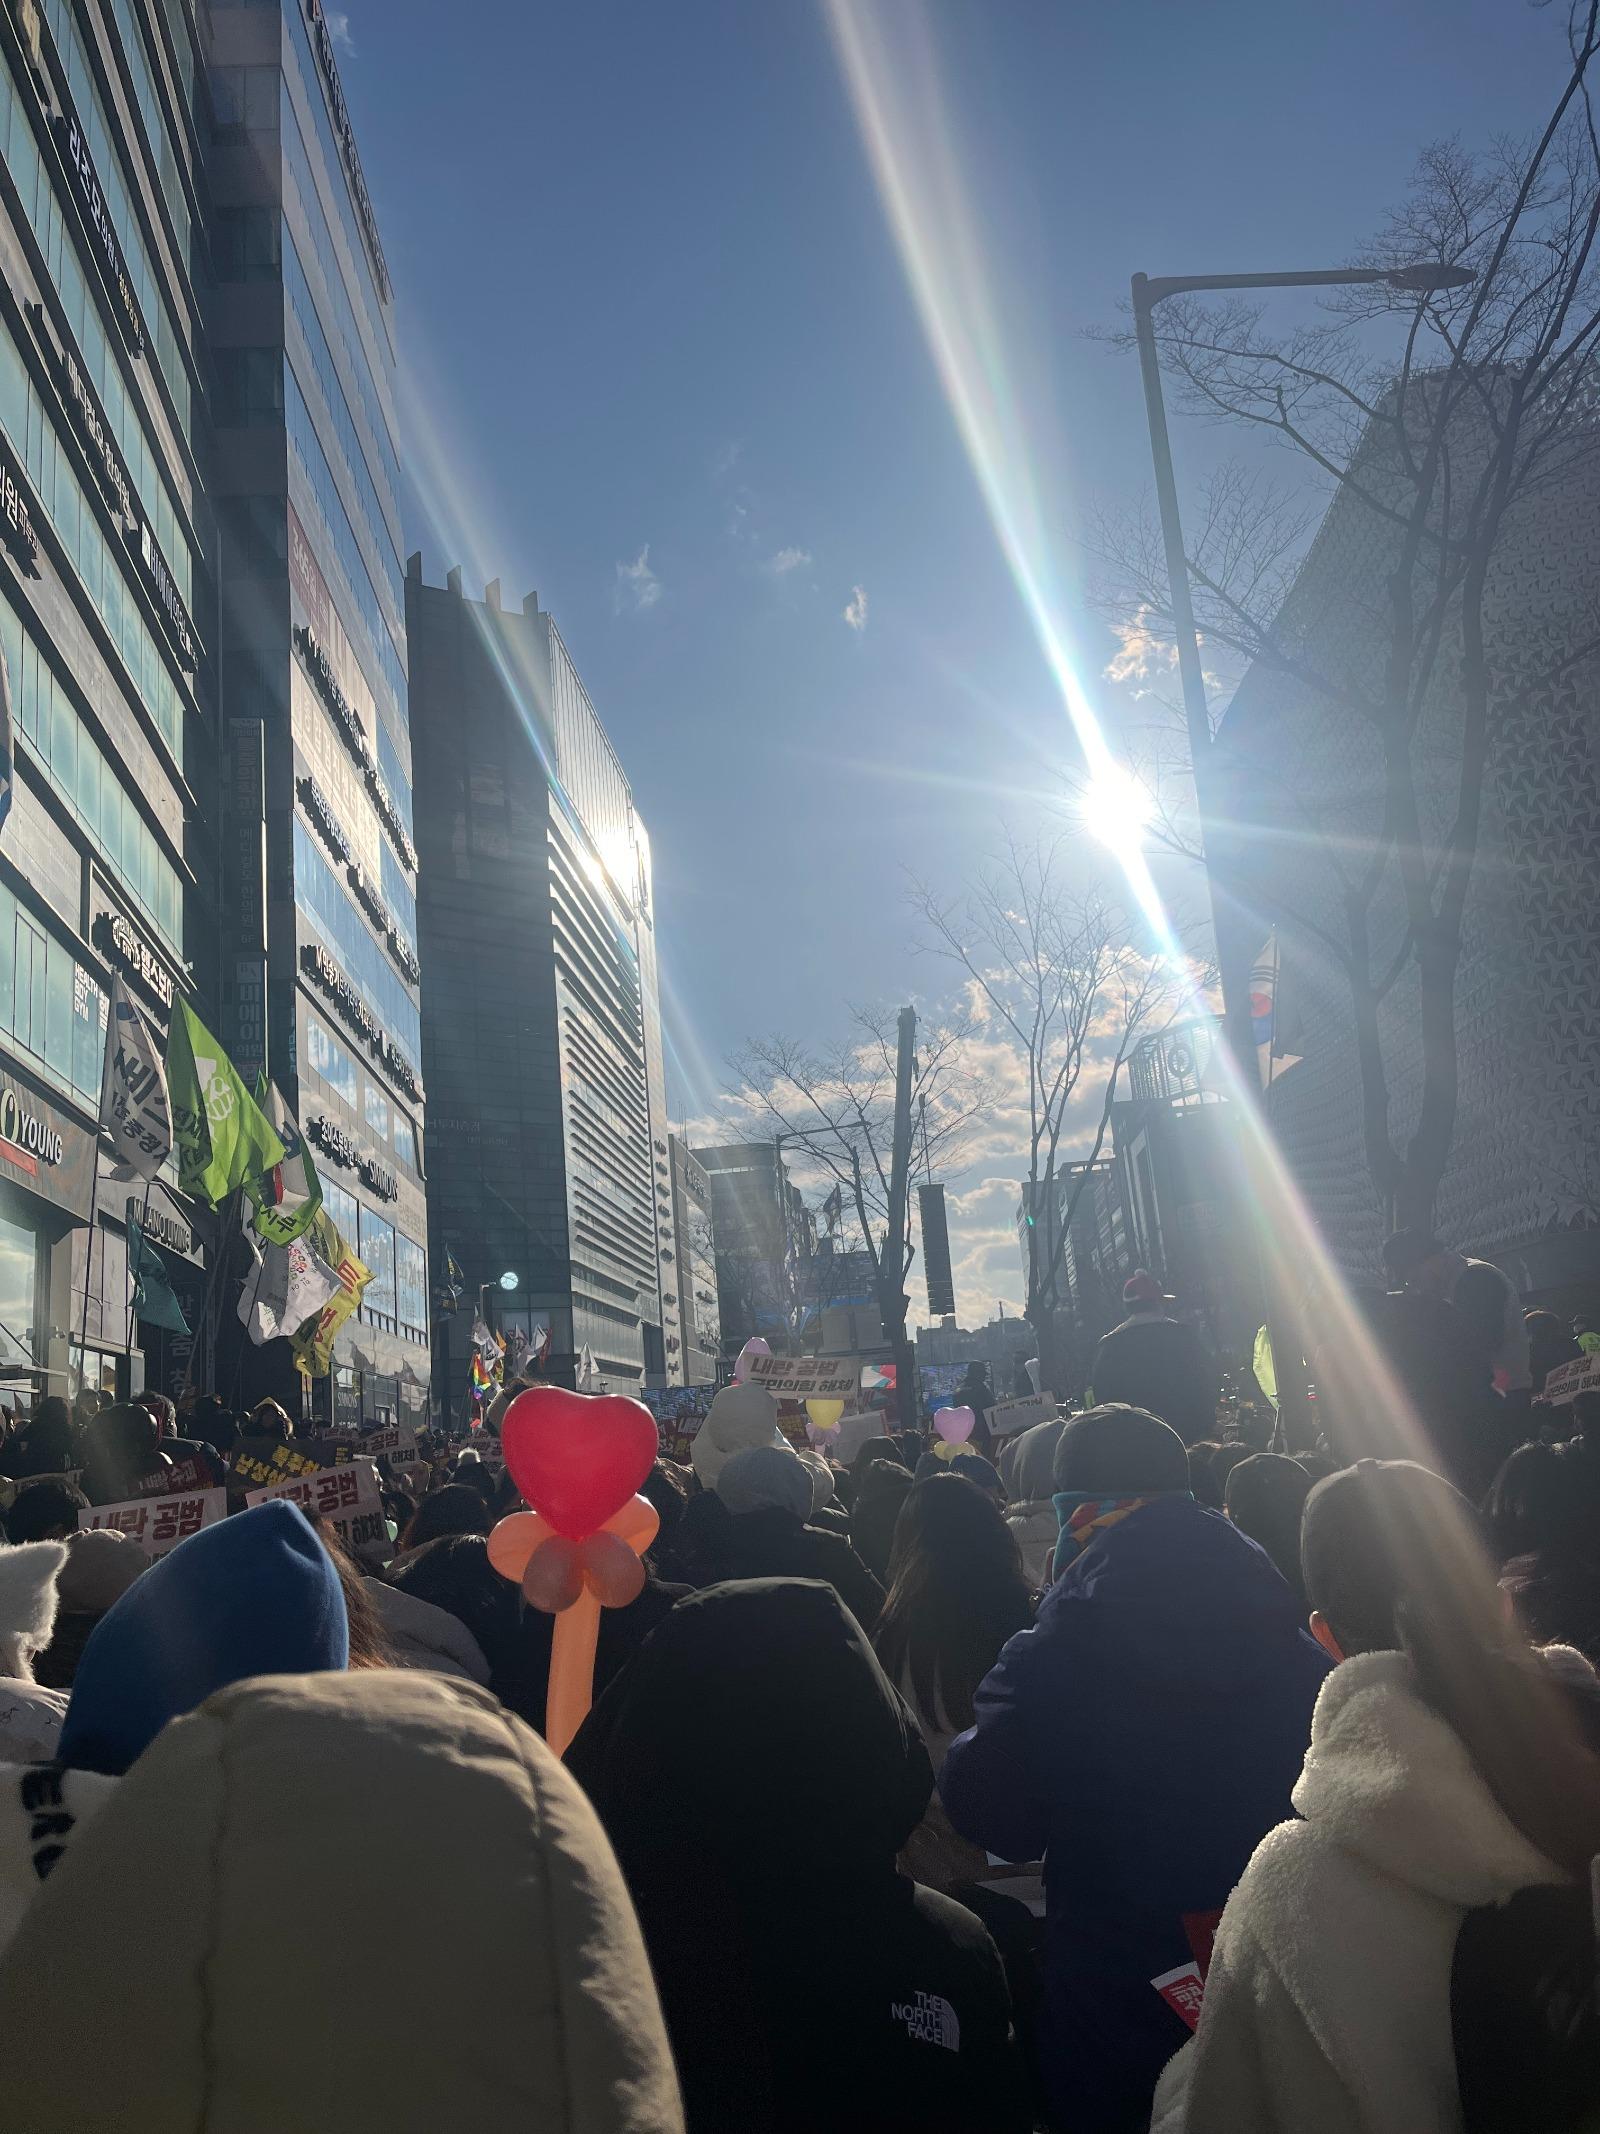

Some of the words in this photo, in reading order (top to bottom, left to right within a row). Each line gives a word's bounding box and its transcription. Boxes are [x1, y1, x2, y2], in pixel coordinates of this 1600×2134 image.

[75, 961, 98, 998] HEALTH
[75, 978, 88, 1003] BOY
[75, 995, 89, 1022] GYM
[20, 1110, 62, 1165] YOUNG
[167, 1218, 190, 1252] LIVING
[750, 1357, 794, 1377] 내란
[316, 1470, 360, 1514] 공범
[153, 1498, 205, 1541] 공범
[891, 2001, 942, 2028] NORTH
[914, 1990, 942, 2012] THE
[907, 2021, 942, 2046] FACE
